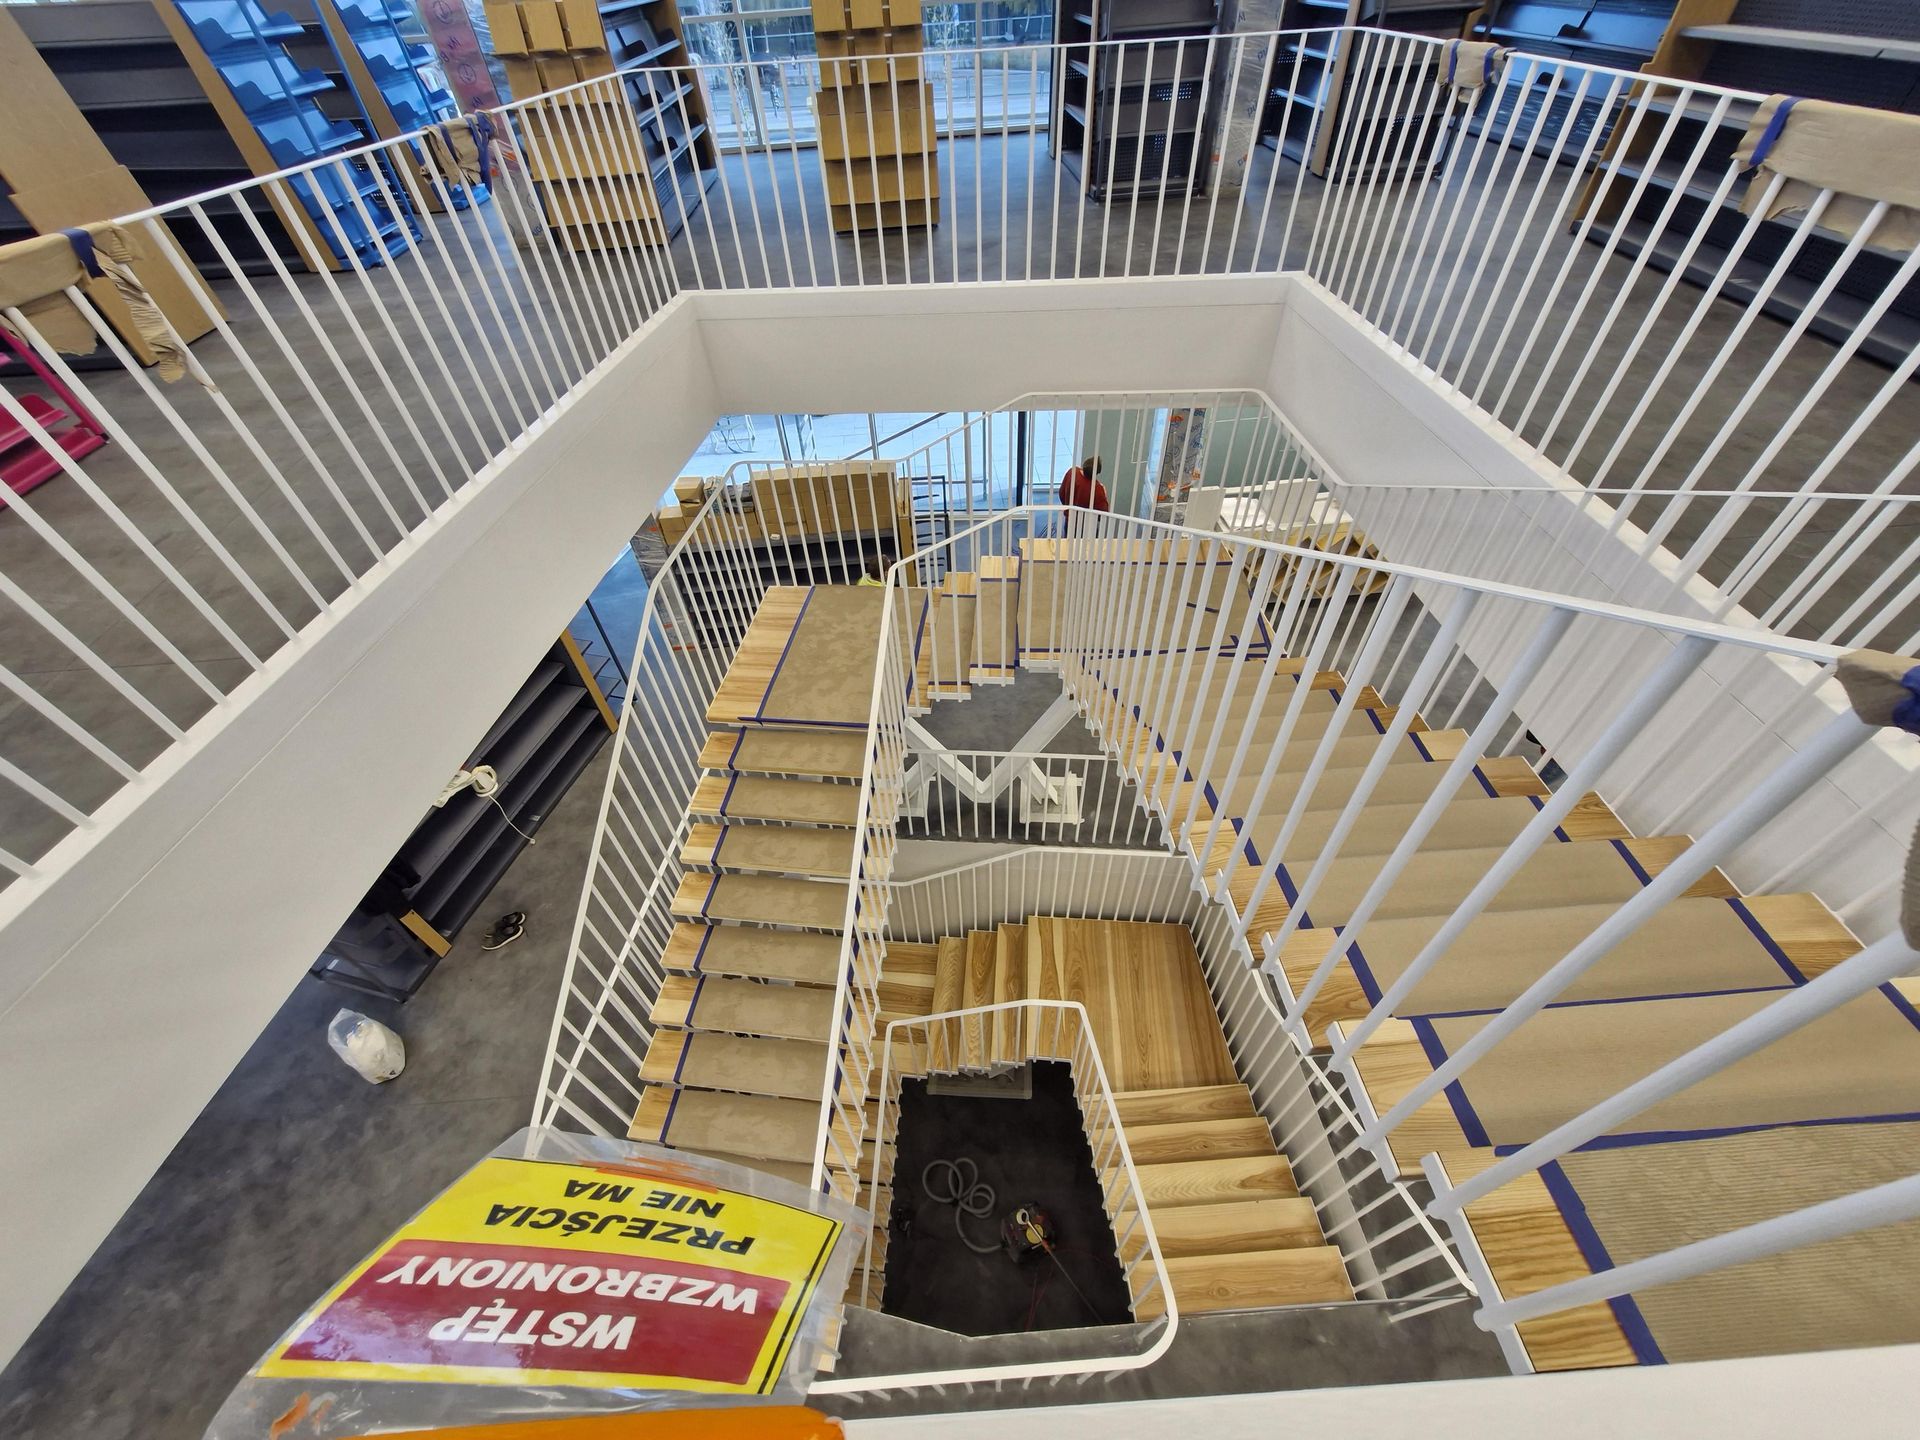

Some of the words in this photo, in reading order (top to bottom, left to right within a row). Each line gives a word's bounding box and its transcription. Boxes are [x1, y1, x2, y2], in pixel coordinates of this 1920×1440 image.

[563, 1179, 634, 1203] MA
[640, 1190, 725, 1218] NIE
[484, 1204, 755, 1255] PRZEJŚCIA
[376, 1255, 759, 1314] WZBRONIONY
[428, 1298, 637, 1350] WSTĘP
